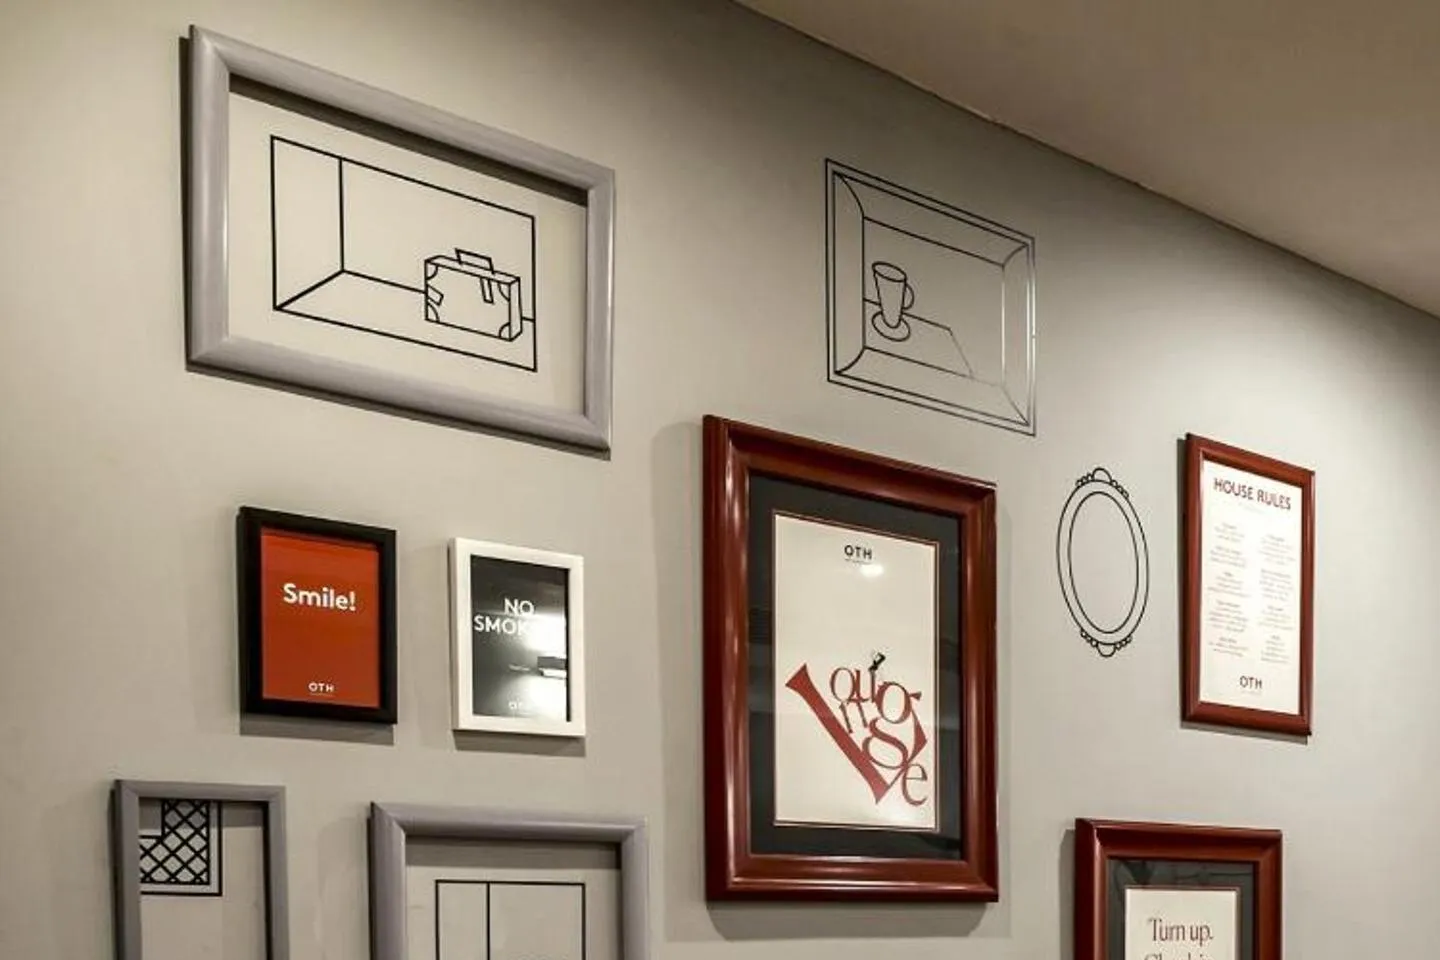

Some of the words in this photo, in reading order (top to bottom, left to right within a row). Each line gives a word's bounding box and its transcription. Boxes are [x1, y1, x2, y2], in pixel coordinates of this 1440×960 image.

[1213, 477, 1254, 501] HOUSE
[1257, 487, 1292, 511] RULES
[844, 544, 873, 560] OTH
[283, 582, 356, 611] Smile!
[504, 597, 535, 617] NO
[473, 614, 538, 638] SMOK
[308, 682, 335, 693] OTH
[1239, 675, 1263, 690] OTH
[1148, 917, 1186, 942] Turn
[1189, 923, 1214, 946] up.
